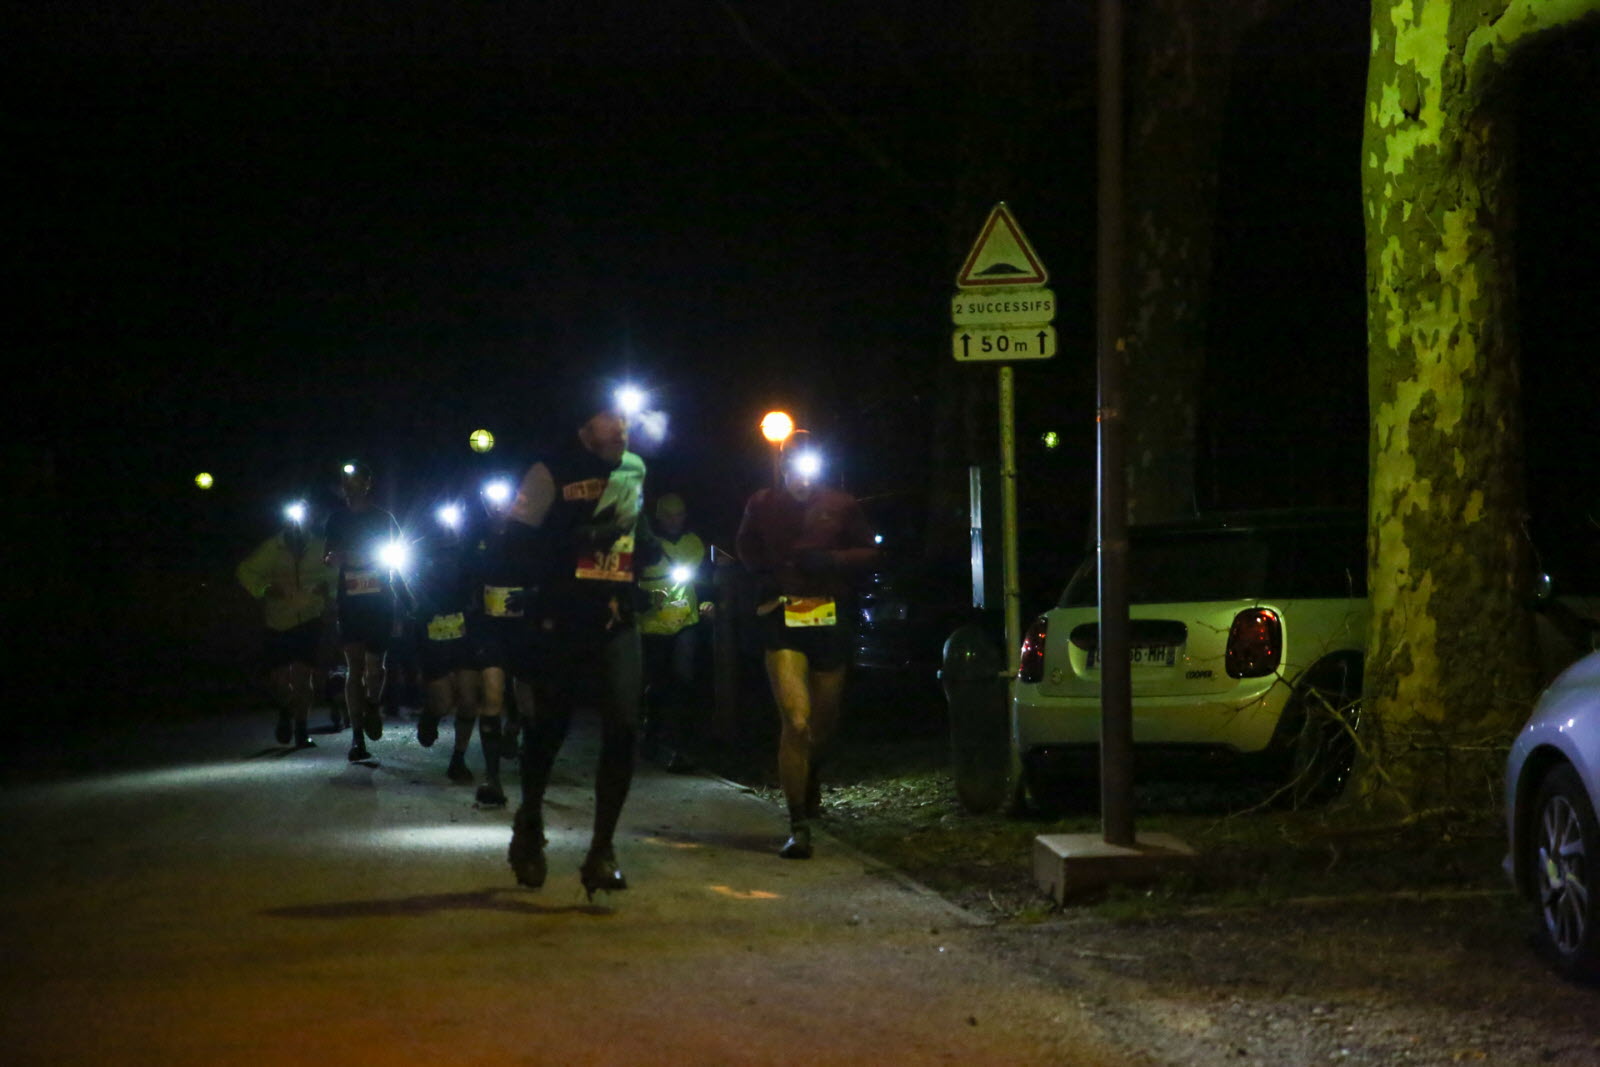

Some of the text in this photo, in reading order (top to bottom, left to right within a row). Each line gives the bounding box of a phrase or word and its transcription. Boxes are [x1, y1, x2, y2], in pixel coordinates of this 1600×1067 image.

[955, 301, 1051, 314] 2 SUCCESSIFS
[1185, 669, 1213, 680] COOPER
